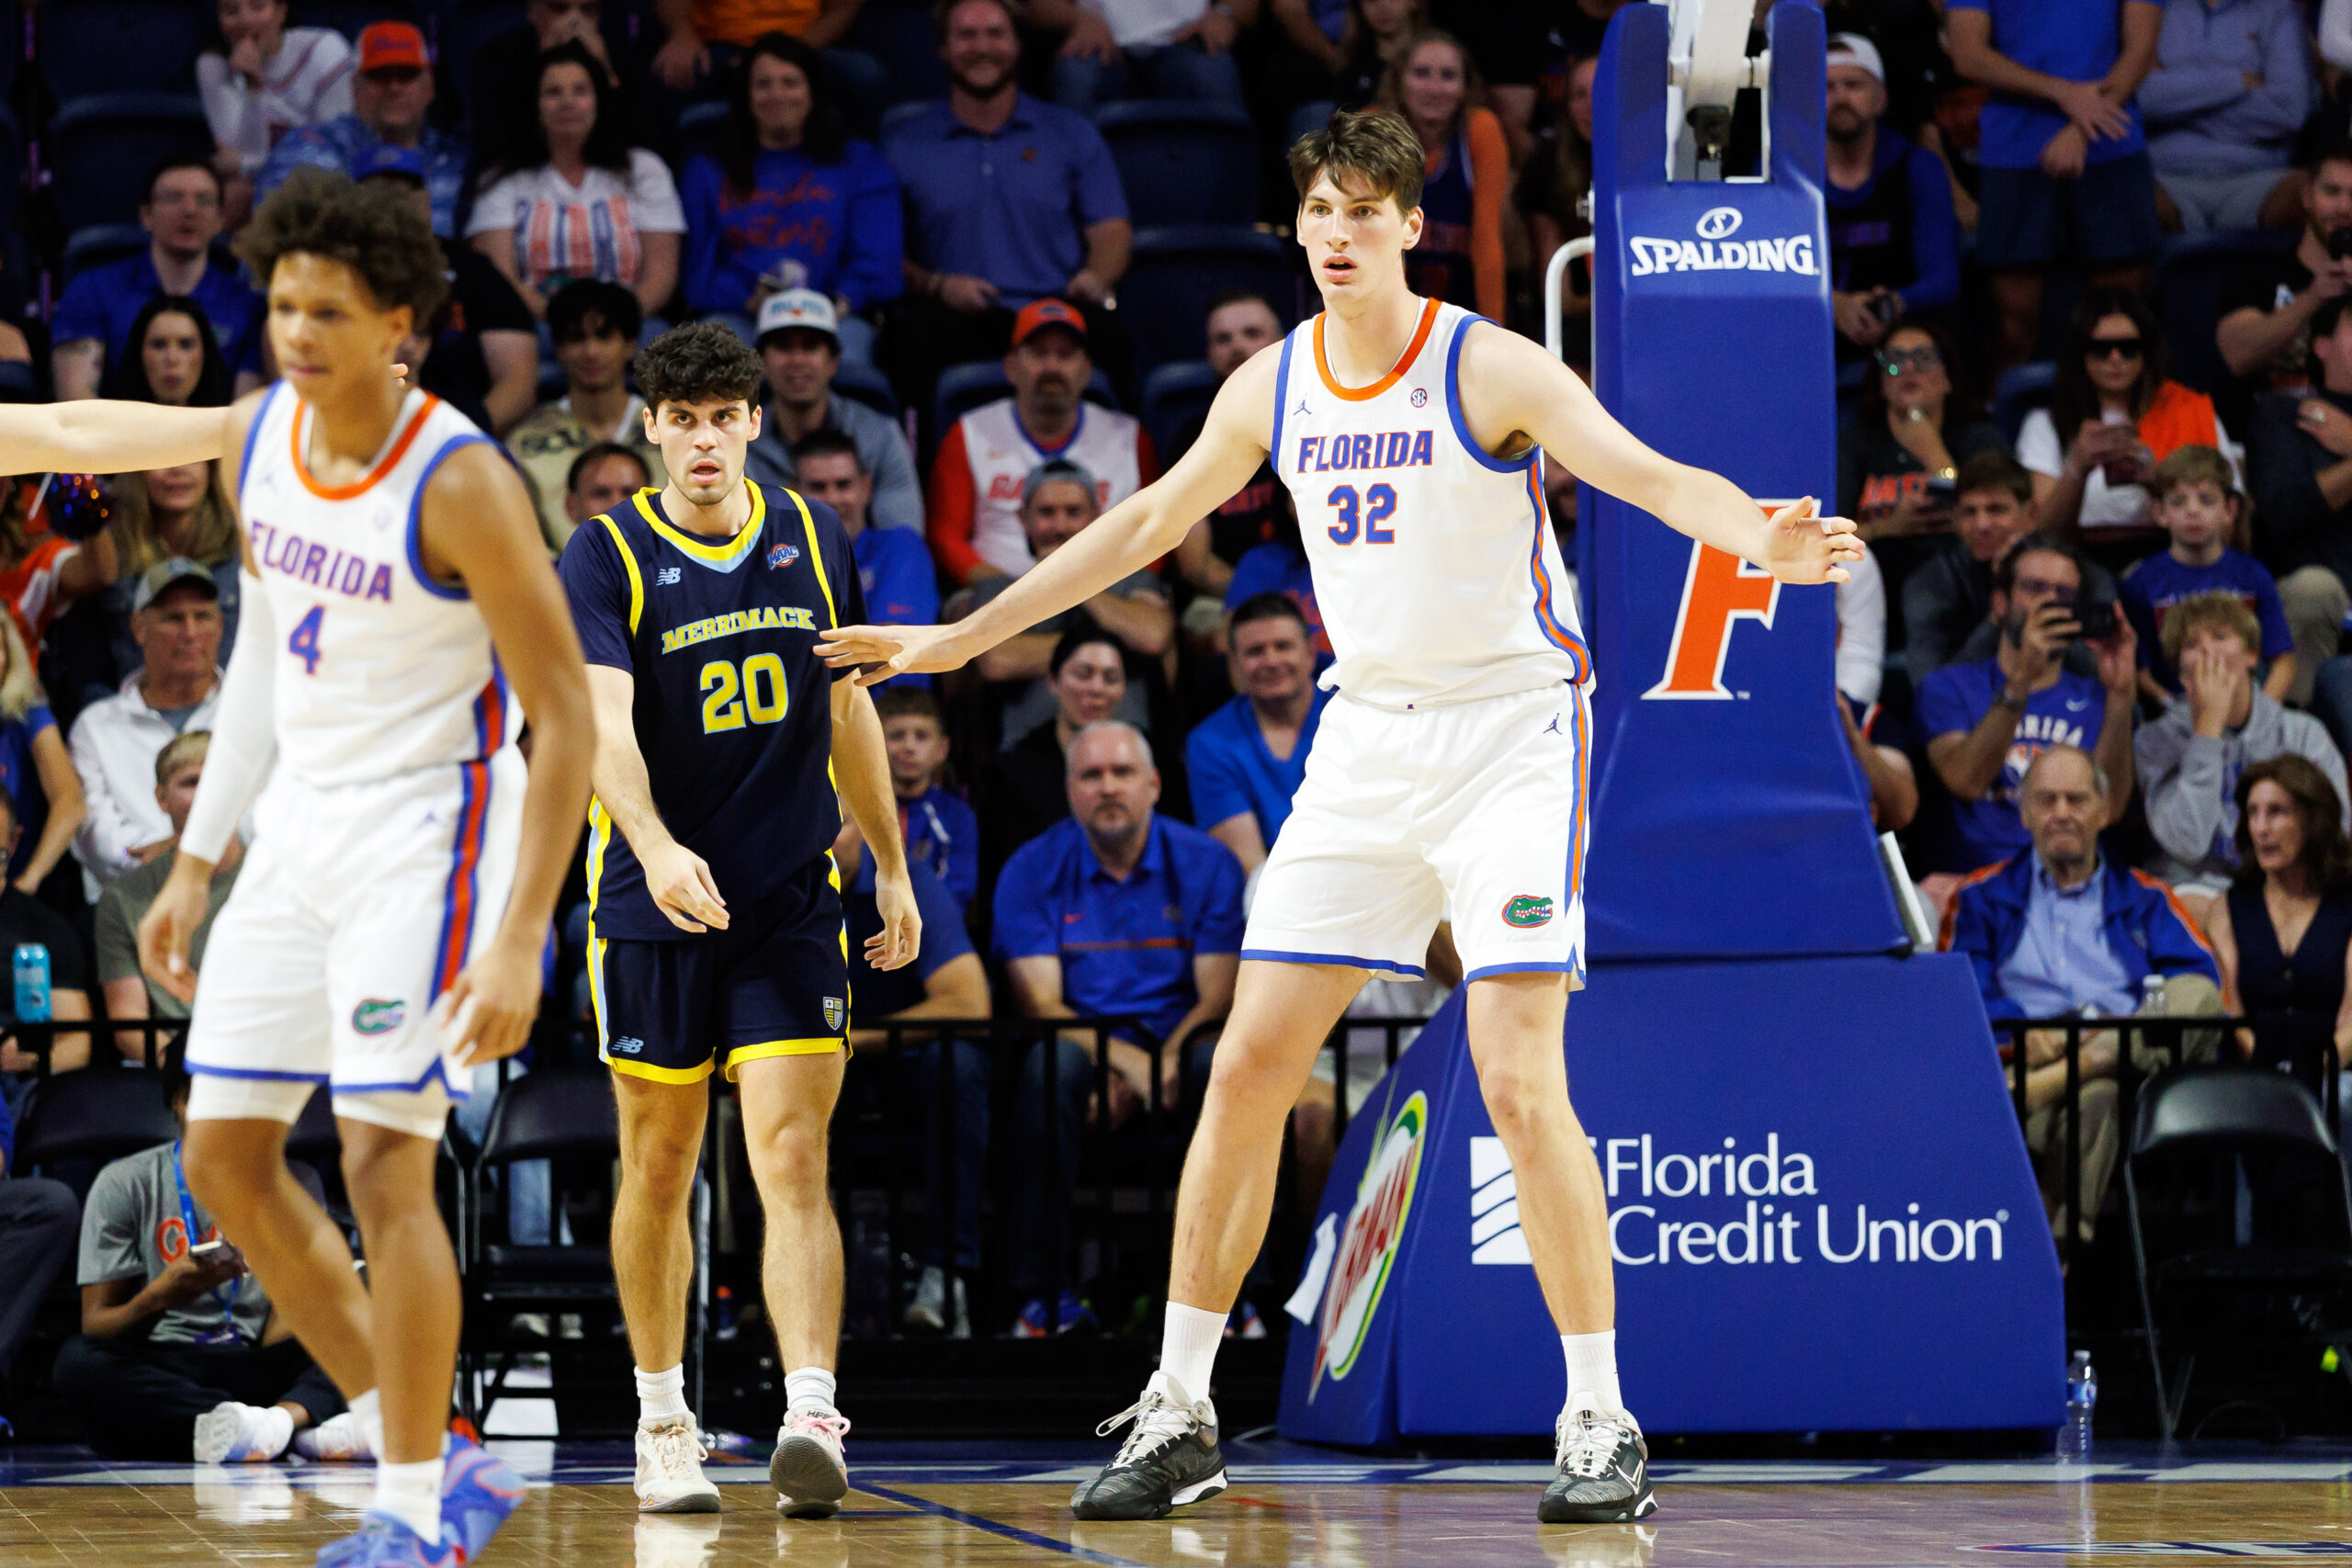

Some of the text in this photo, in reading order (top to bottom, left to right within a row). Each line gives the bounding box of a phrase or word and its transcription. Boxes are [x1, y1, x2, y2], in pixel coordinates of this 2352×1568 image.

[1630, 234, 1814, 276] SPALDING
[1297, 430, 1433, 473] FLORIDA
[1328, 483, 1397, 546] 32
[767, 545, 799, 570] MAAC
[288, 604, 325, 676] 4
[662, 606, 817, 655] MERRIMACK
[700, 652, 789, 735] 20
[1607, 1133, 1818, 1197] Florida
[1609, 1201, 1802, 1266] Credit
